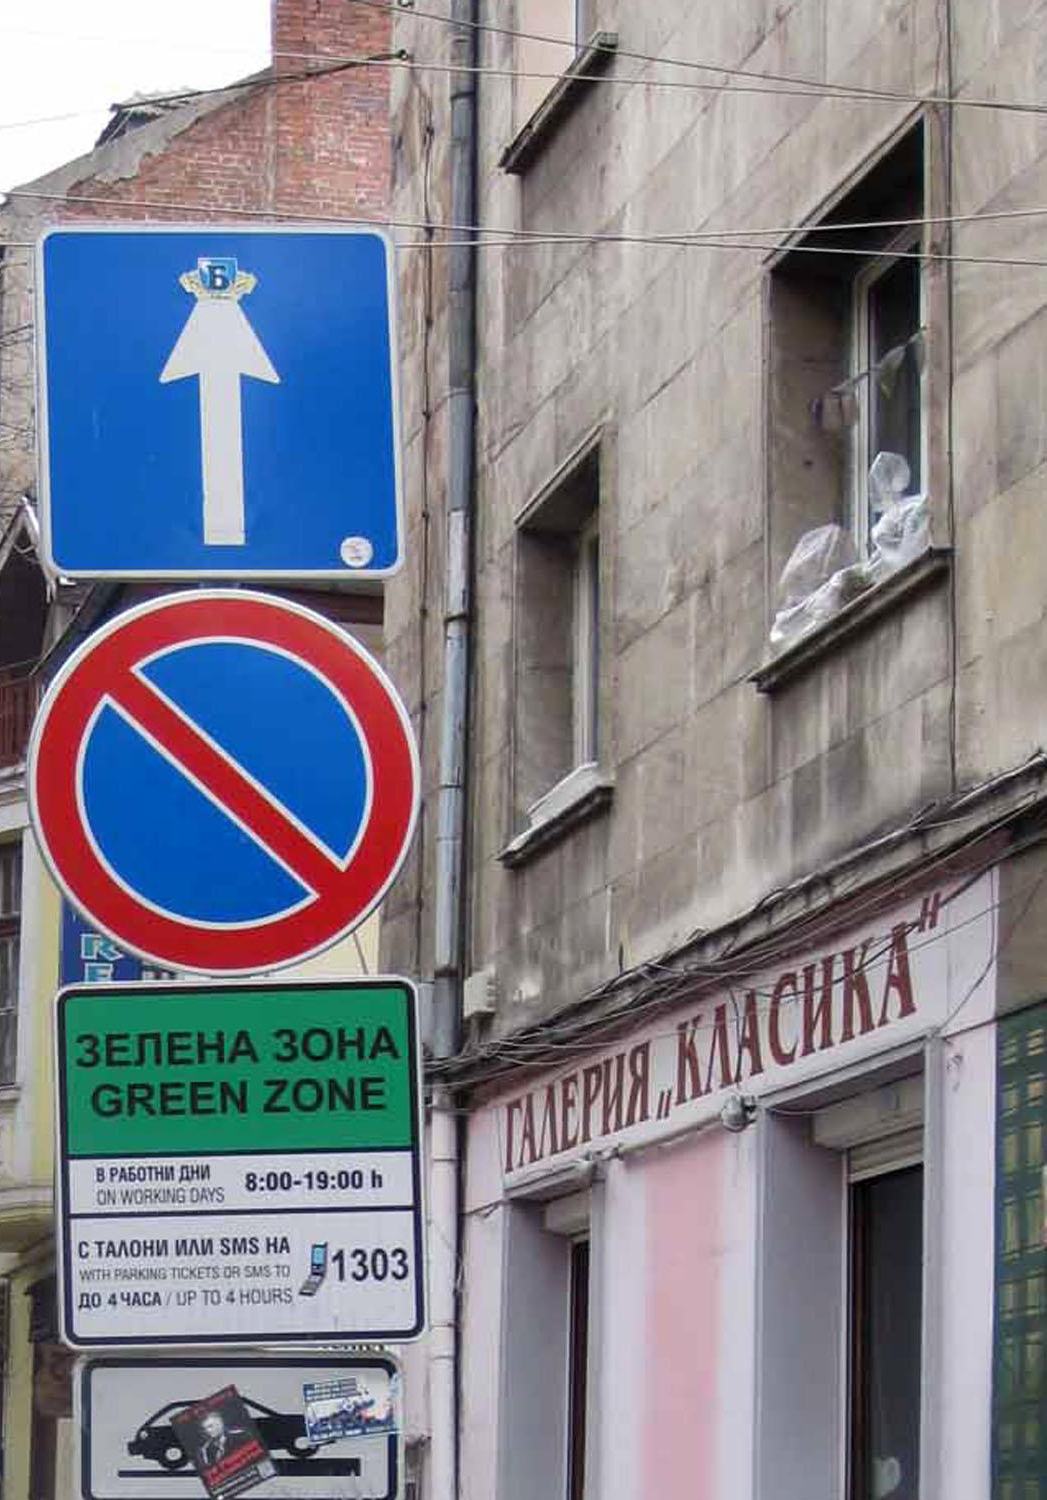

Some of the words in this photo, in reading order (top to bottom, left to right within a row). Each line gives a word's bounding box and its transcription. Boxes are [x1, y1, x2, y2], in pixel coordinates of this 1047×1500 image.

[75, 1030, 259, 1068] ЗЕЛЕНА
[272, 1026, 400, 1063] ЗОНА
[91, 1081, 248, 1117] GREEN
[263, 1077, 387, 1113] ZONE
[505, 1040, 651, 1174] ГАЛЕРИЯ
[96, 1167, 105, 1183] В
[110, 1165, 175, 1182] РАБОТНИ
[179, 1164, 211, 1182] ДНИ
[245, 1170, 363, 1192] 8:00-19:00
[371, 1169, 383, 1189] h
[96, 1189, 116, 1205] ON
[120, 1188, 186, 1205] WORKING
[189, 1187, 225, 1203] DAYS
[95, 1239, 168, 1258] ТАЛОНИ
[175, 1238, 214, 1256] ИЛИ
[220, 1236, 259, 1255] SMS
[266, 1236, 291, 1254] НА
[79, 1268, 110, 1281] WITH
[115, 1267, 167, 1280] PARKING
[171, 1266, 220, 1280] TICKETS
[223, 1265, 241, 1279] OR
[244, 1264, 273, 1278] SMS
[276, 1264, 291, 1278] TO
[332, 1247, 409, 1282] 1303
[78, 1292, 102, 1309] ДО
[108, 1293, 118, 1307] 4
[120, 1291, 162, 1307] ЧАСА
[176, 1290, 197, 1306] UP
[201, 1289, 221, 1305] TO
[225, 1290, 235, 1303] 4
[239, 1287, 293, 1304] HOURS
